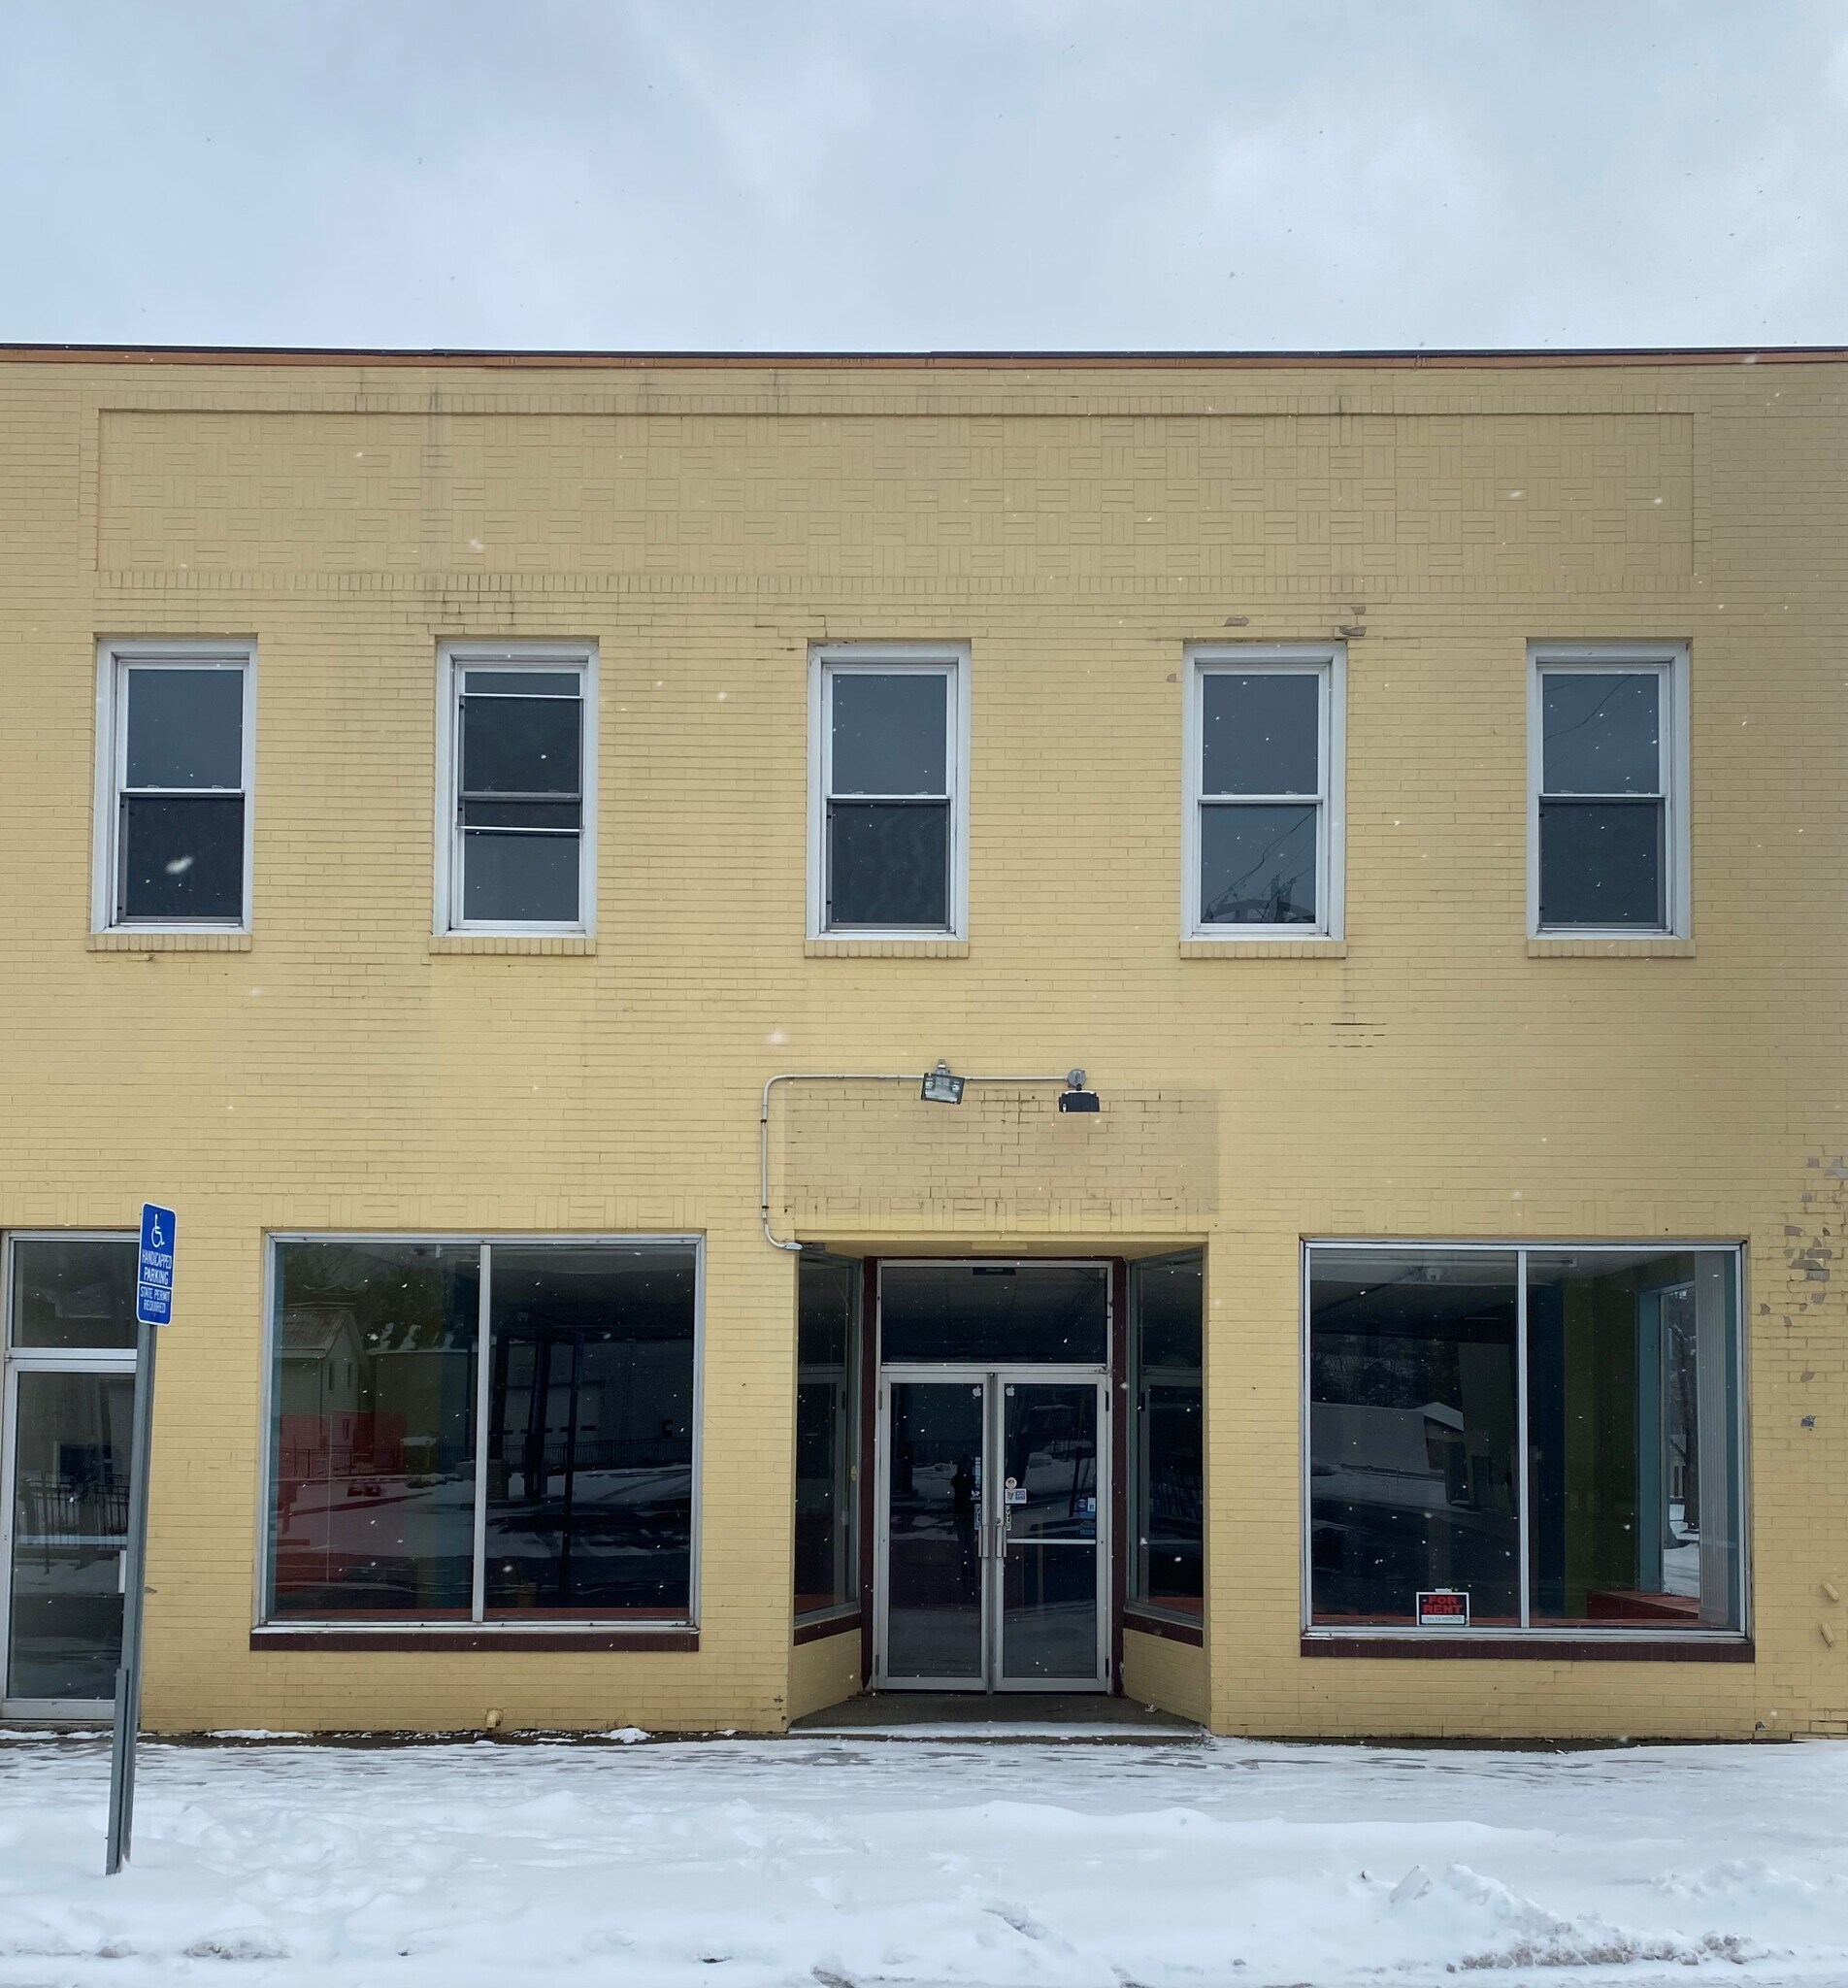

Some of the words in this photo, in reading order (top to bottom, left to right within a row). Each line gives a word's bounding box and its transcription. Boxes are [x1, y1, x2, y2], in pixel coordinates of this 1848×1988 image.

[142, 1249, 172, 1270] HANDICAPPED
[144, 1267, 169, 1285] PARKING
[140, 1286, 152, 1299] STATE
[153, 1289, 171, 1302] PERMIT
[144, 1299, 166, 1313] REQUIRED
[1428, 1596, 1457, 1605] FOR
[1423, 1605, 1463, 1614] RENT
